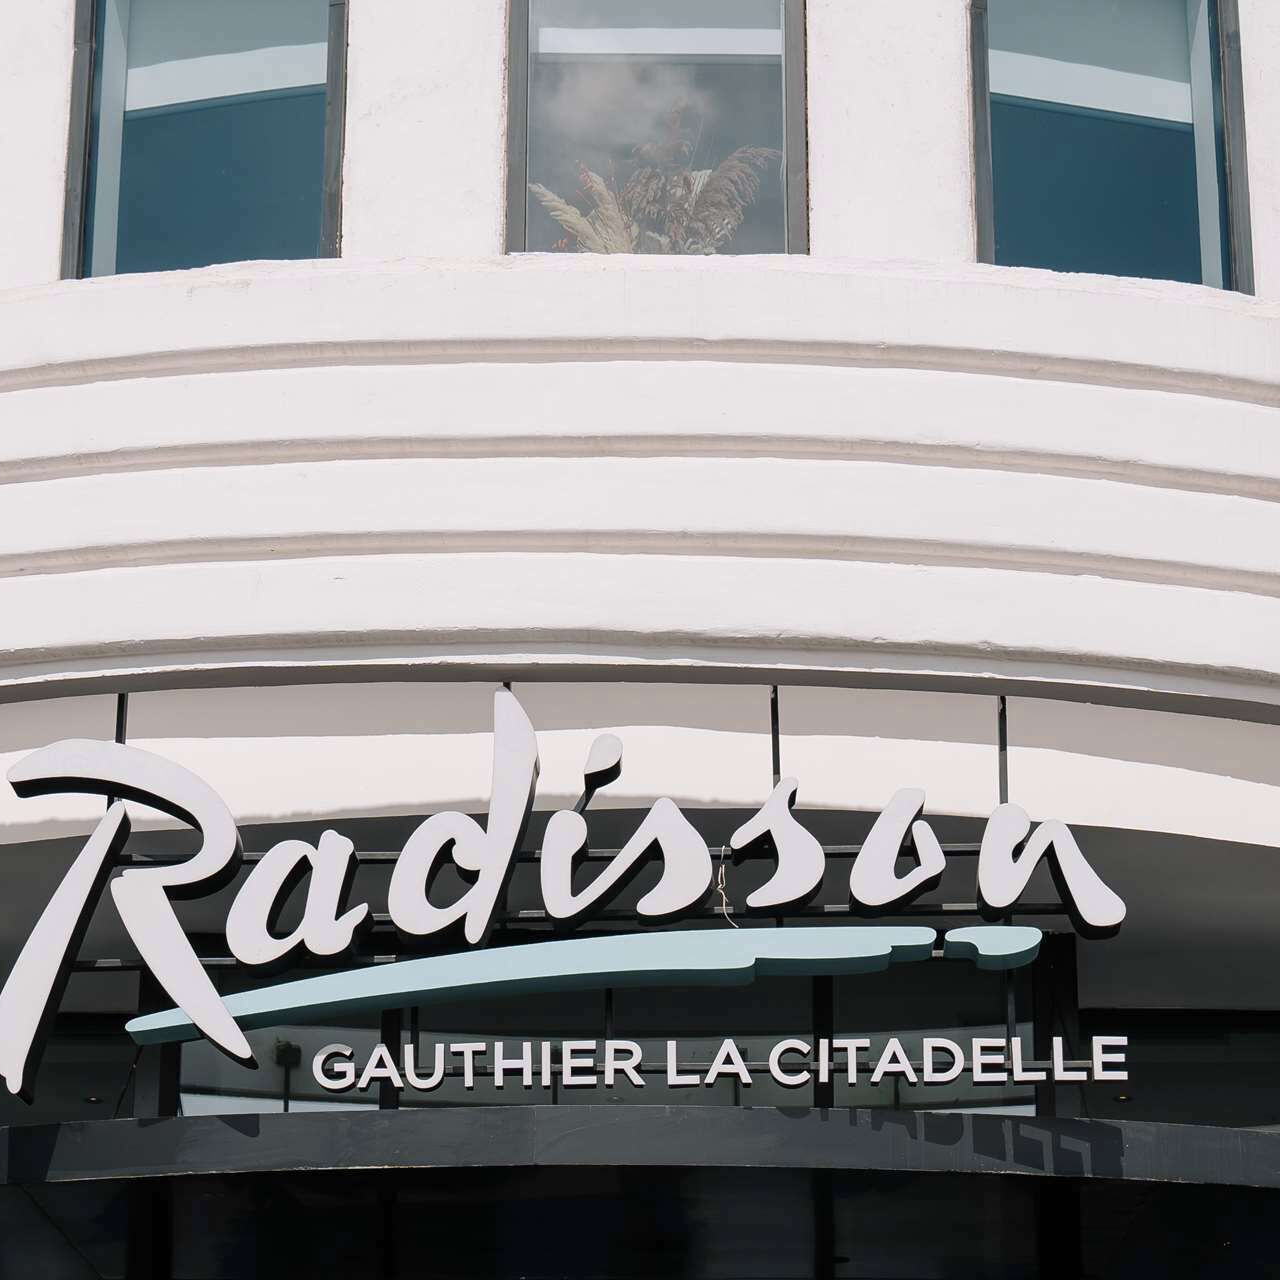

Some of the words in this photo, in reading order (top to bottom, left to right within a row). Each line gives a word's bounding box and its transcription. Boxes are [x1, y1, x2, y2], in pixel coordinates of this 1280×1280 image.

[311, 1039, 646, 1091] GAUTHIER
[666, 1039, 753, 1087] LA
[768, 1035, 1129, 1087] CITADELLE
